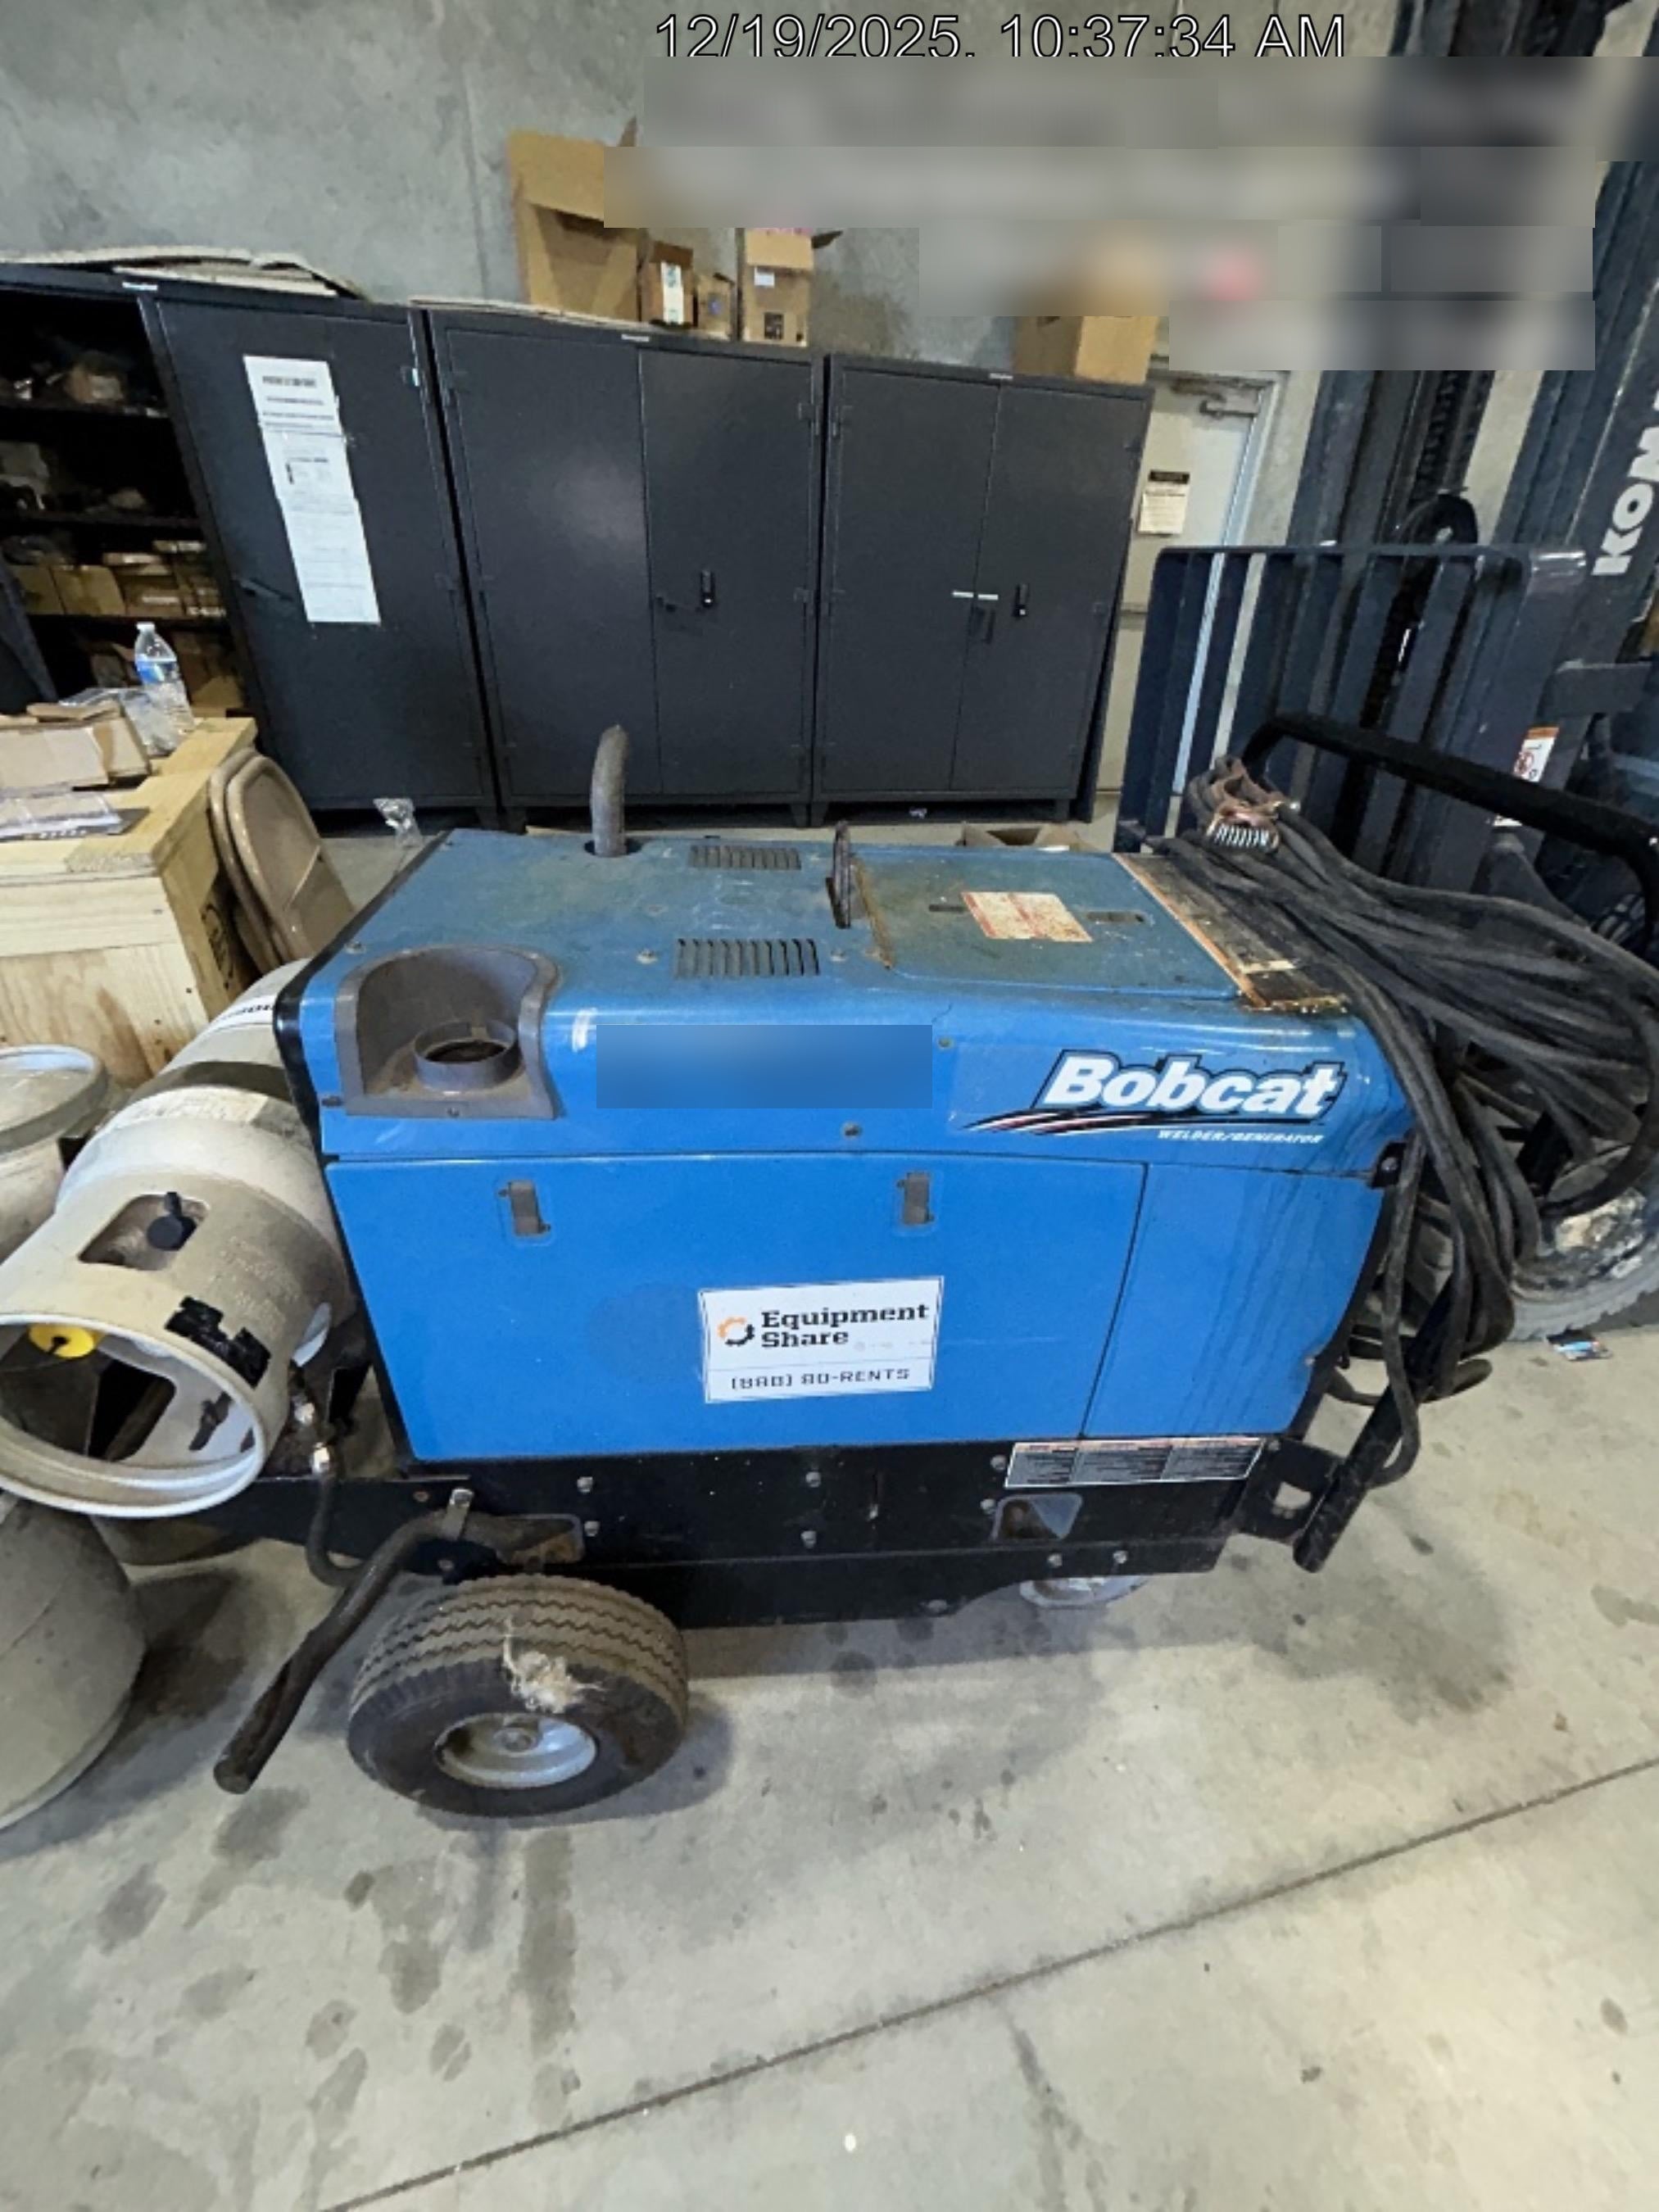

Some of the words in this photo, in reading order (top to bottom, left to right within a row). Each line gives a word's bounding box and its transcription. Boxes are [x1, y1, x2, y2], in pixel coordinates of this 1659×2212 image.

[1591, 389, 1659, 575] KOM
[1040, 1054, 1342, 1117] Bobcat
[1158, 1129, 1325, 1145] WELDER/GENERATOR
[760, 1303, 930, 1330] Equipment
[760, 1330, 849, 1349] Share
